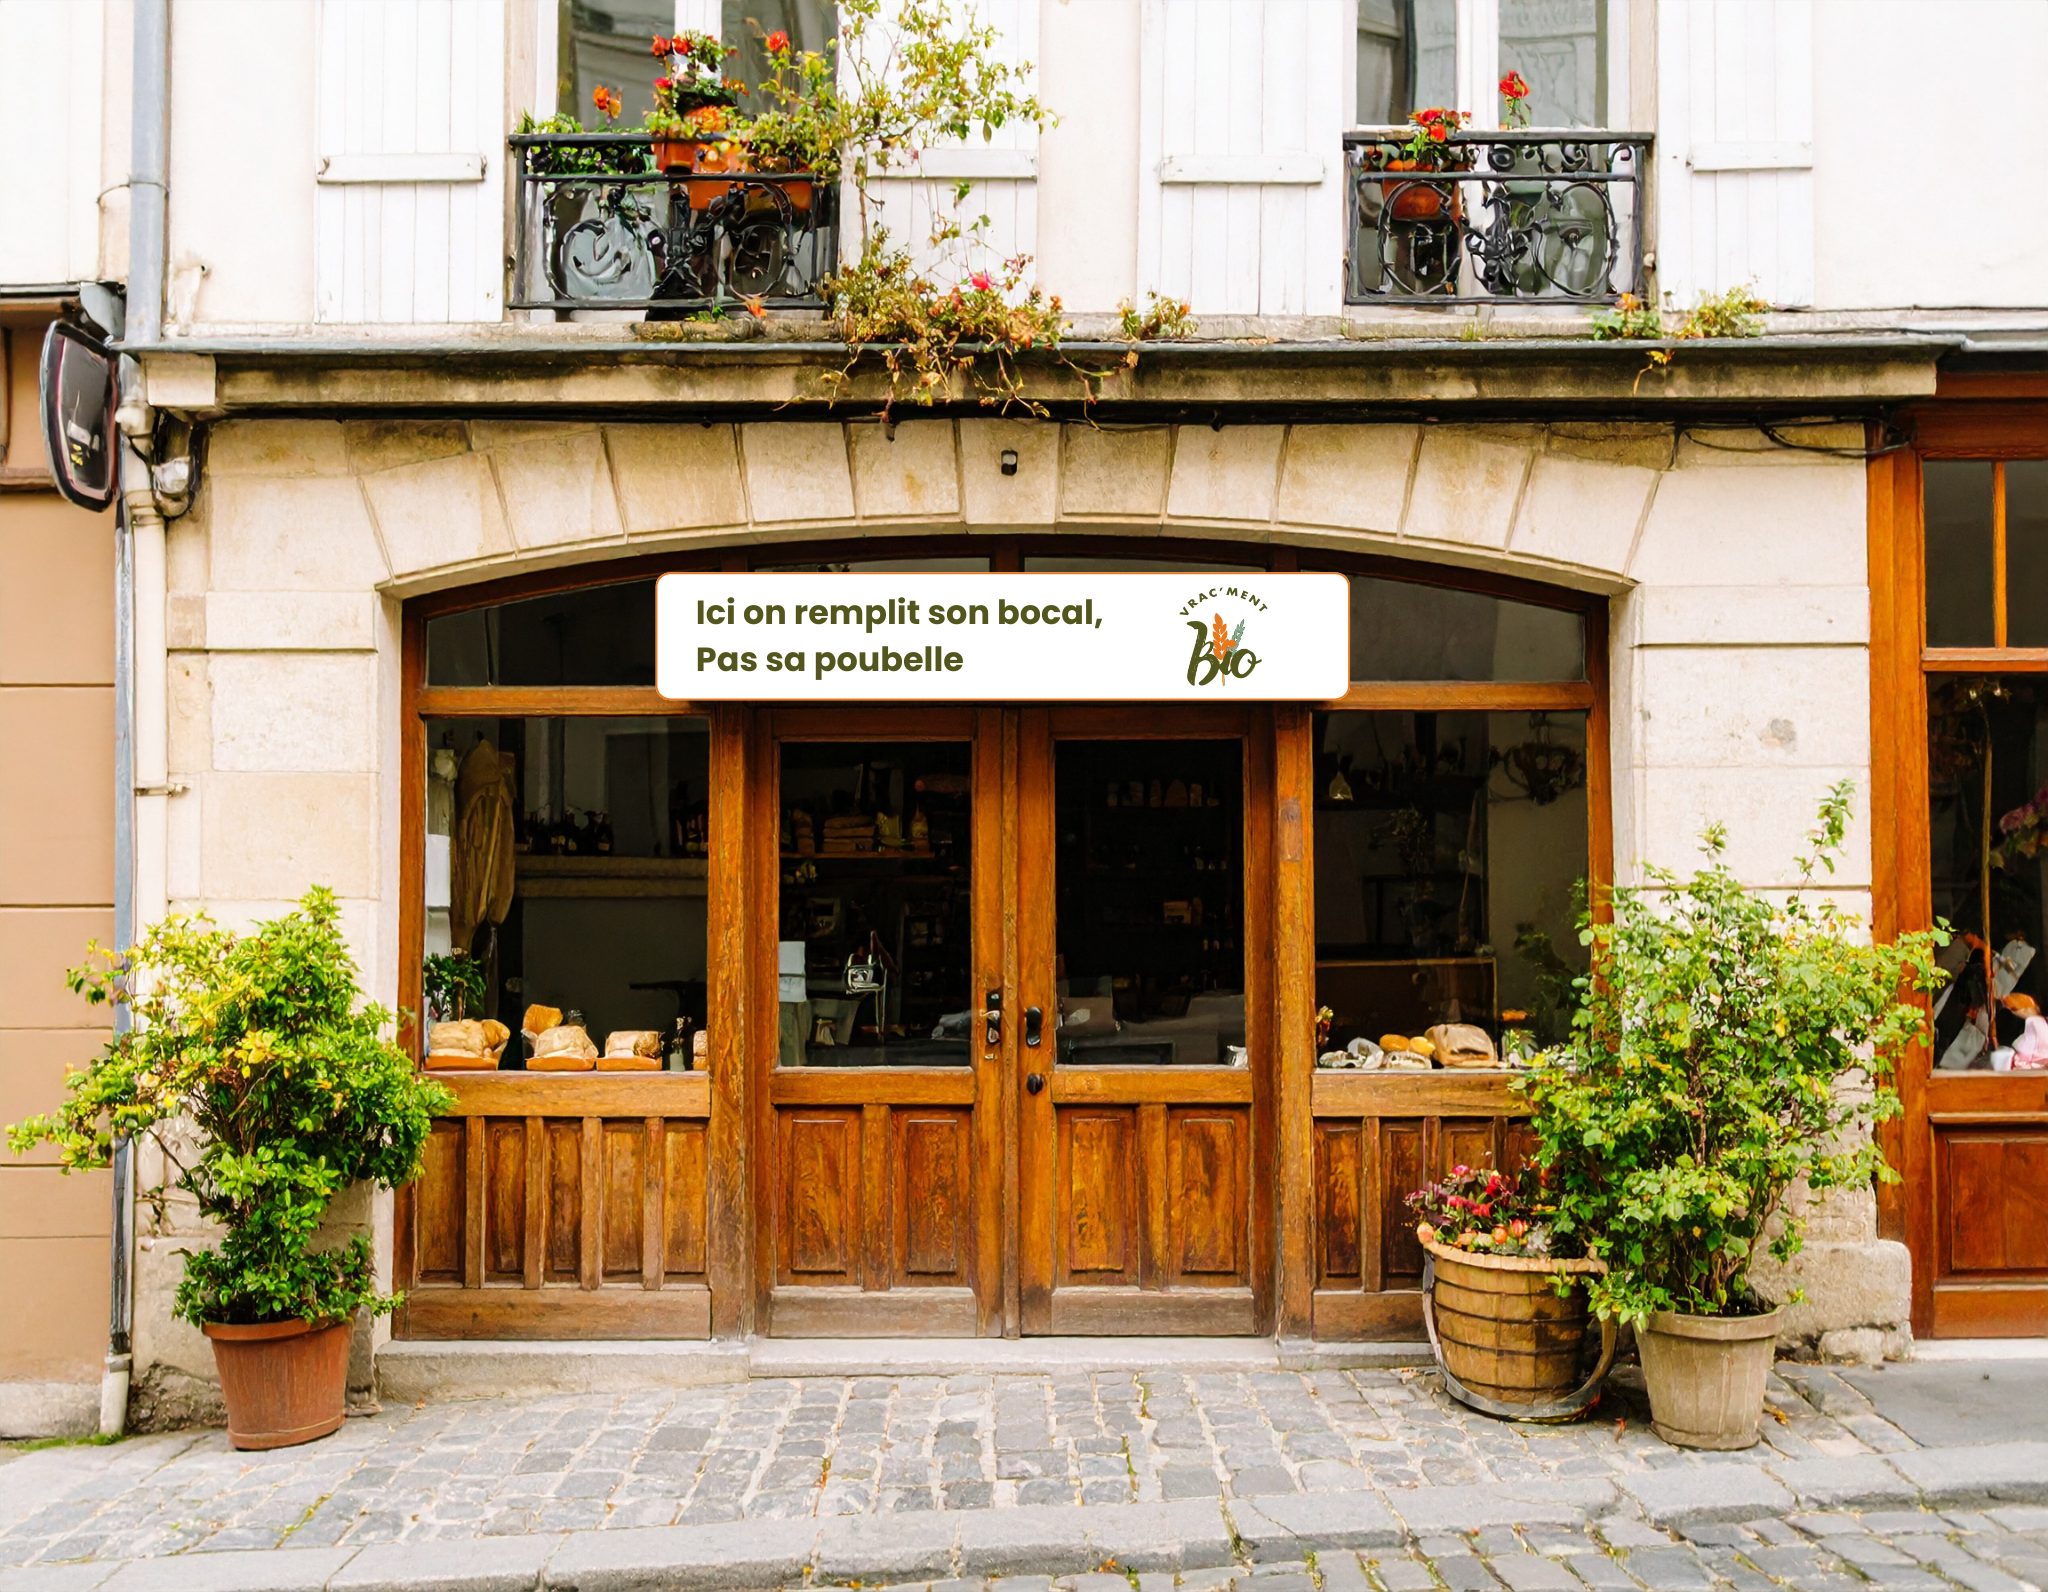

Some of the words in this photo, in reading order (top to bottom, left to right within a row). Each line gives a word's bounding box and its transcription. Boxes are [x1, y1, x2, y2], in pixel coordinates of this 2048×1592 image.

[698, 597, 734, 624] Ici
[744, 604, 785, 625] on
[796, 597, 919, 633] remplit
[929, 604, 988, 625] son
[999, 598, 1102, 629] bocal,
[1180, 587, 1268, 616] VRAC'MENT
[698, 648, 757, 672] Pas
[766, 652, 804, 672] sa
[816, 646, 963, 680] poubelle
[1187, 620, 1262, 687] Bio
